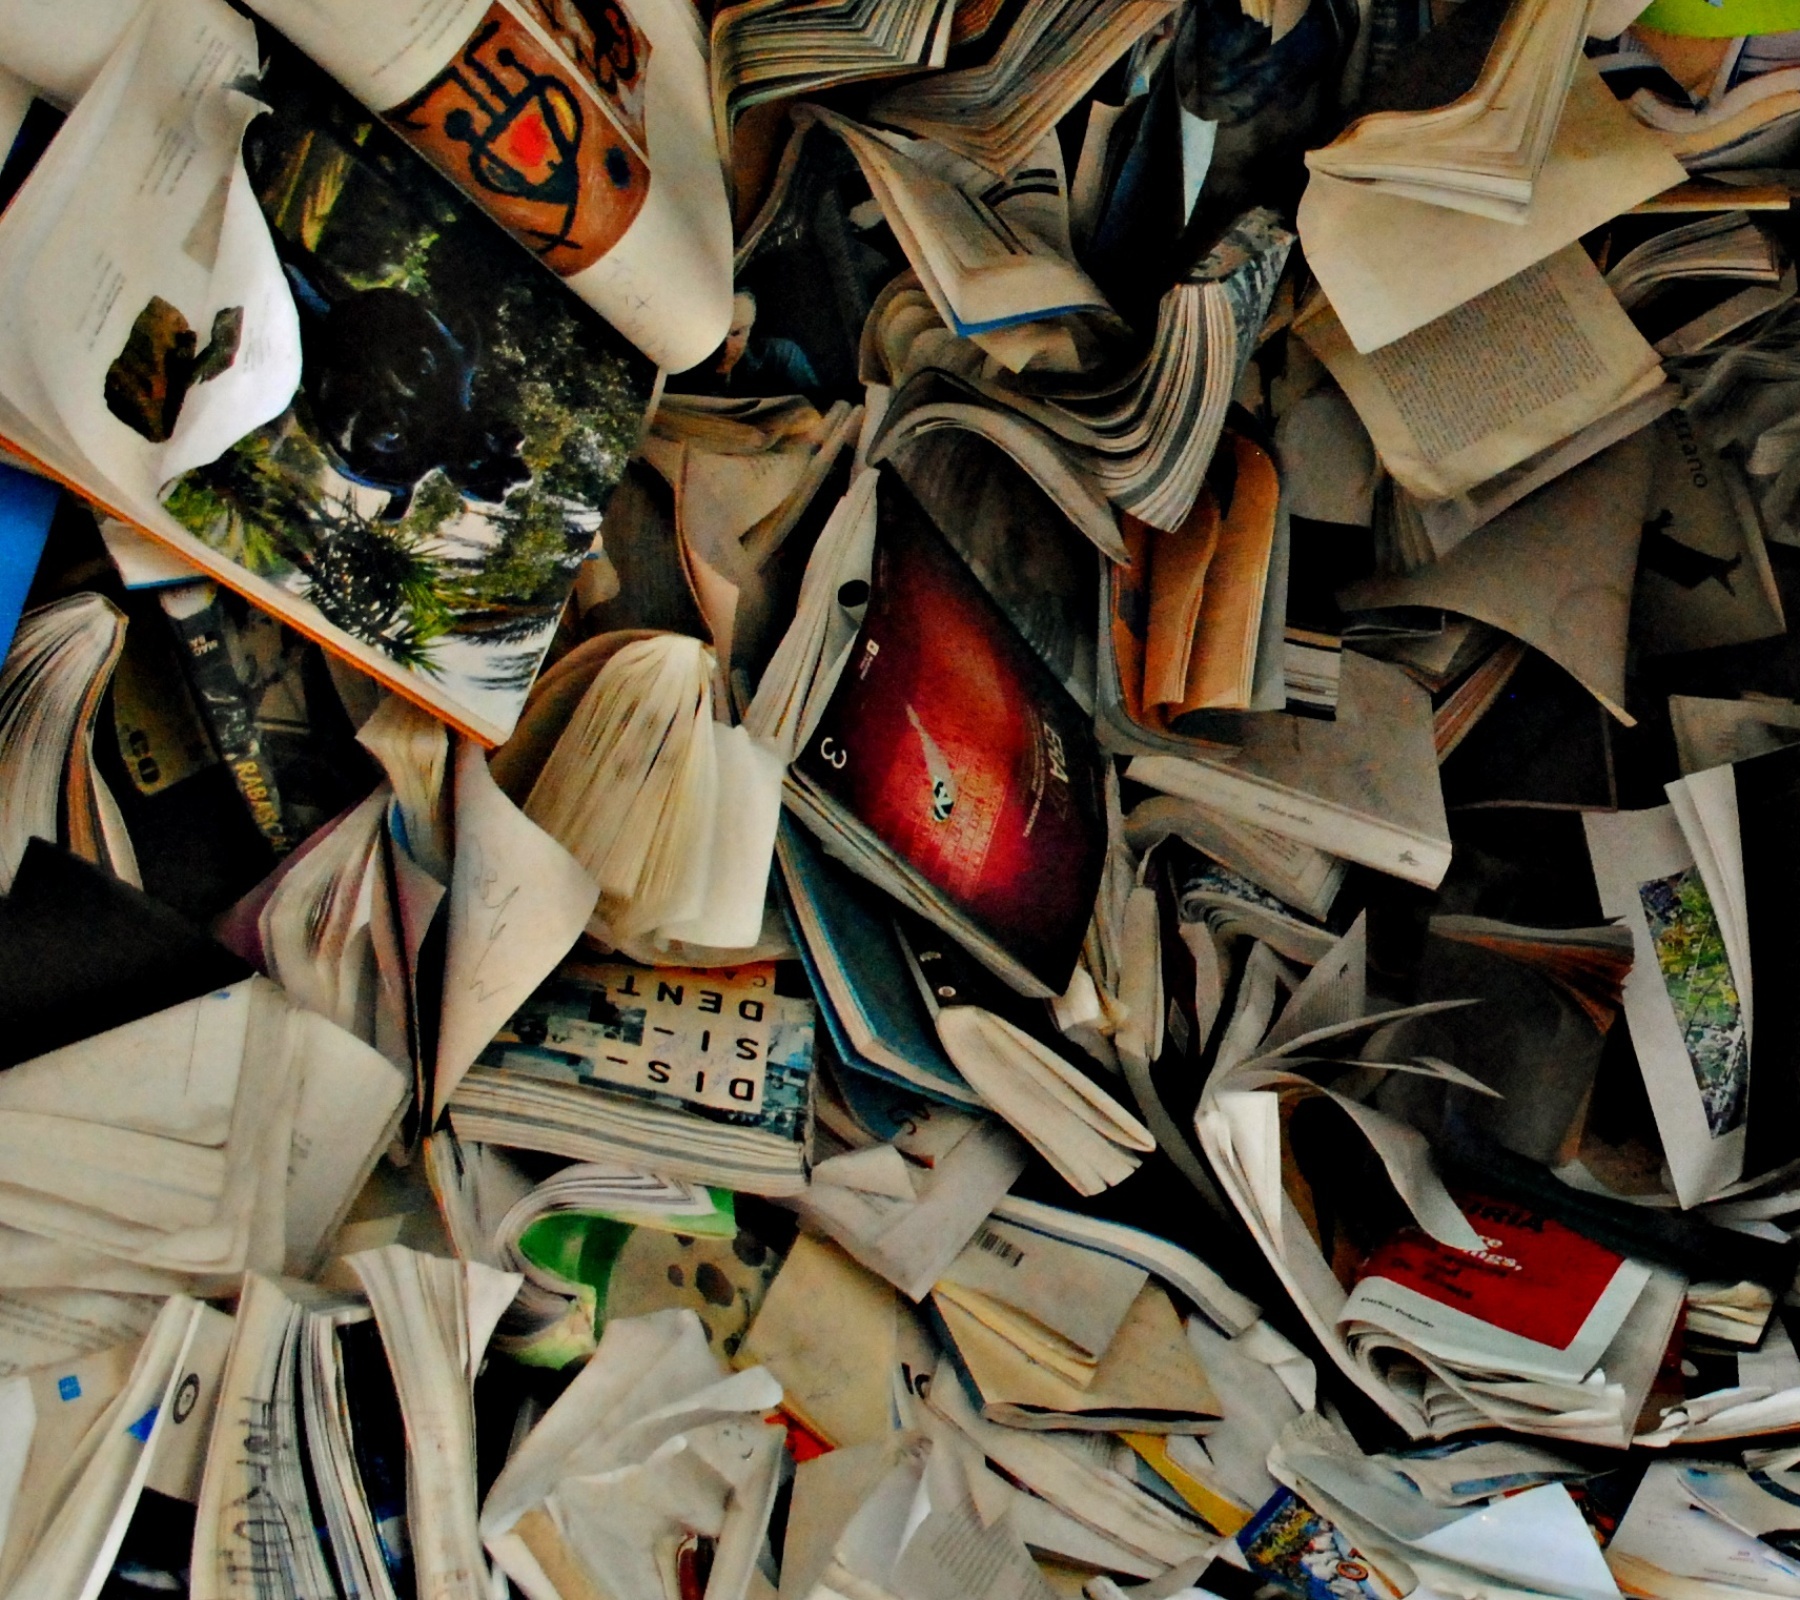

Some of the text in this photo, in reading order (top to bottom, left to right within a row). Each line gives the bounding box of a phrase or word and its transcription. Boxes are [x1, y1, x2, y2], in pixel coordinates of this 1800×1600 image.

[616, 974, 765, 1022] DENT
[652, 1027, 759, 1061] SI-
[605, 1055, 755, 1102] DIS-
